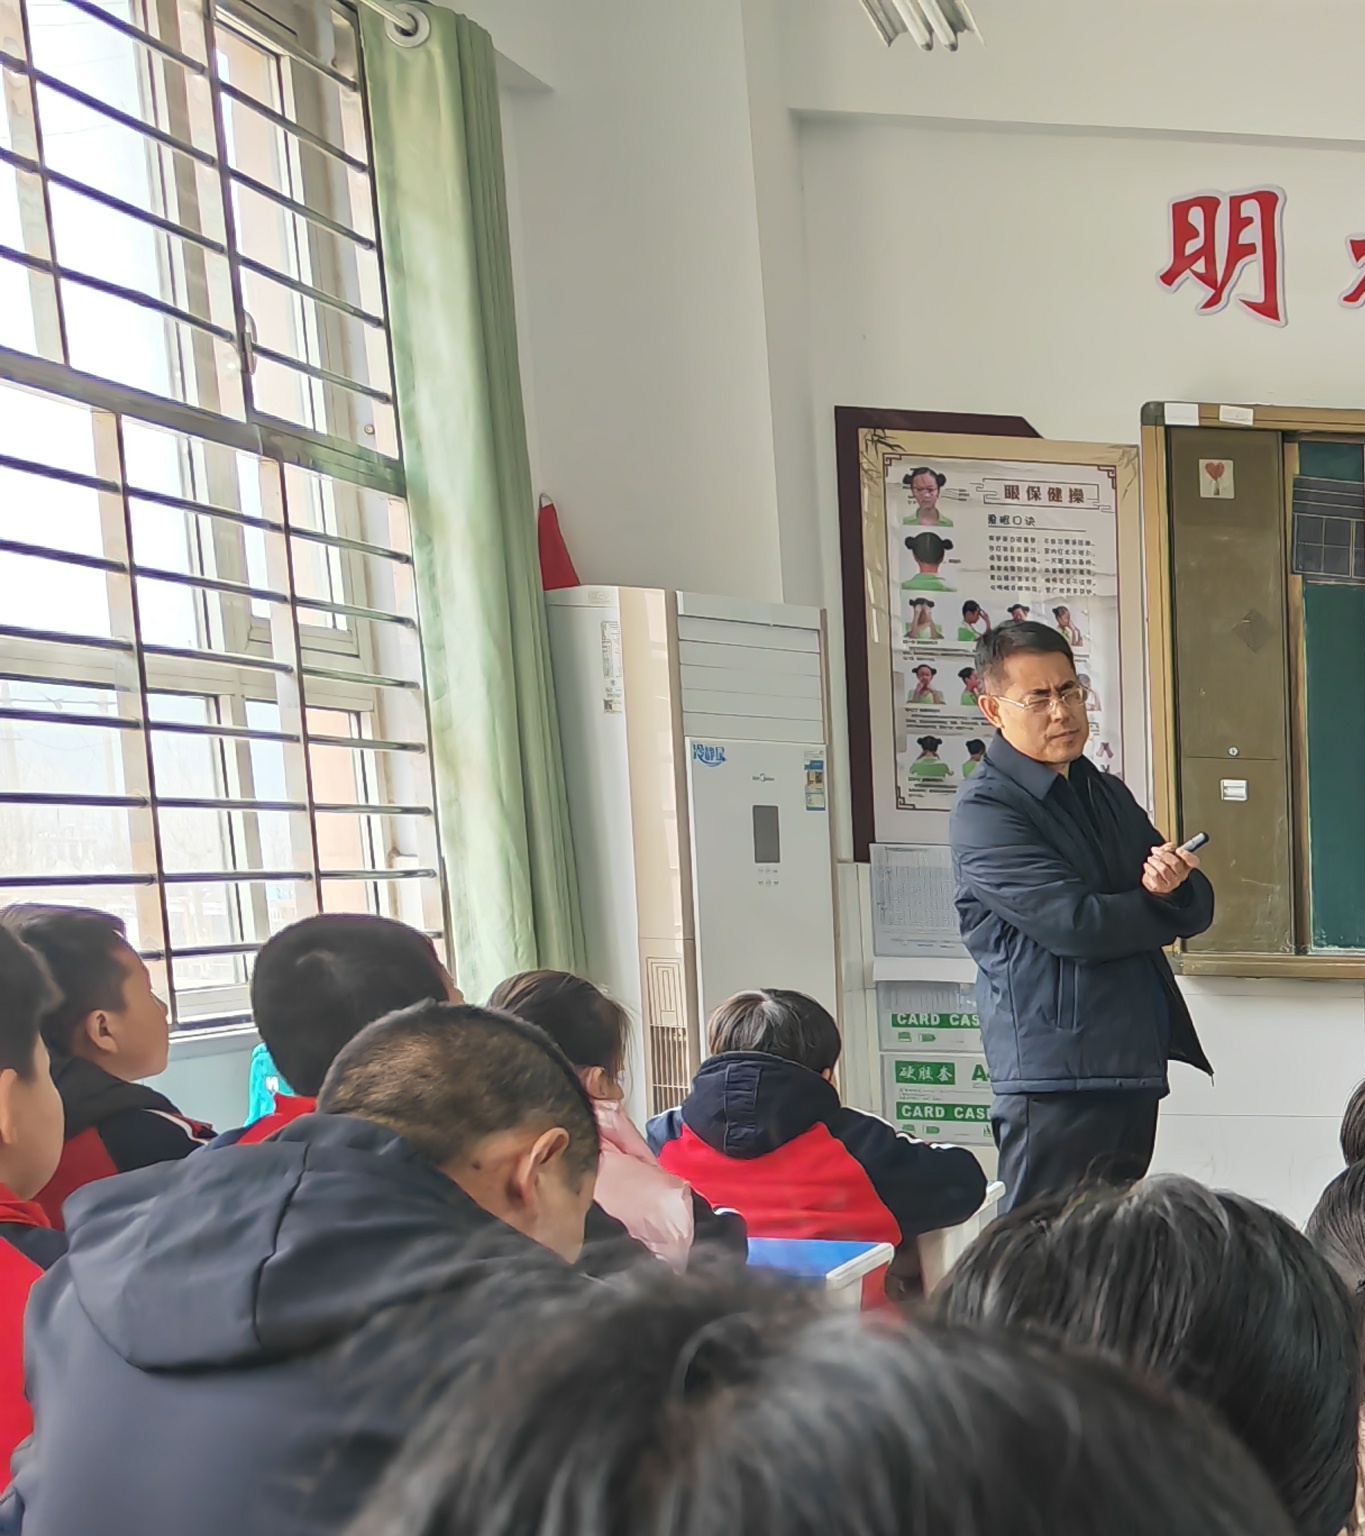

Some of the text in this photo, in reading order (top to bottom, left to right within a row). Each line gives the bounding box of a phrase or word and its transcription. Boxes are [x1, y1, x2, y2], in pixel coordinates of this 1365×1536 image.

[1003, 483, 1085, 504] 眼保健操
[896, 1013, 981, 1026] CARD CAS
[971, 1064, 990, 1081] A
[901, 1105, 945, 1118] CARD
